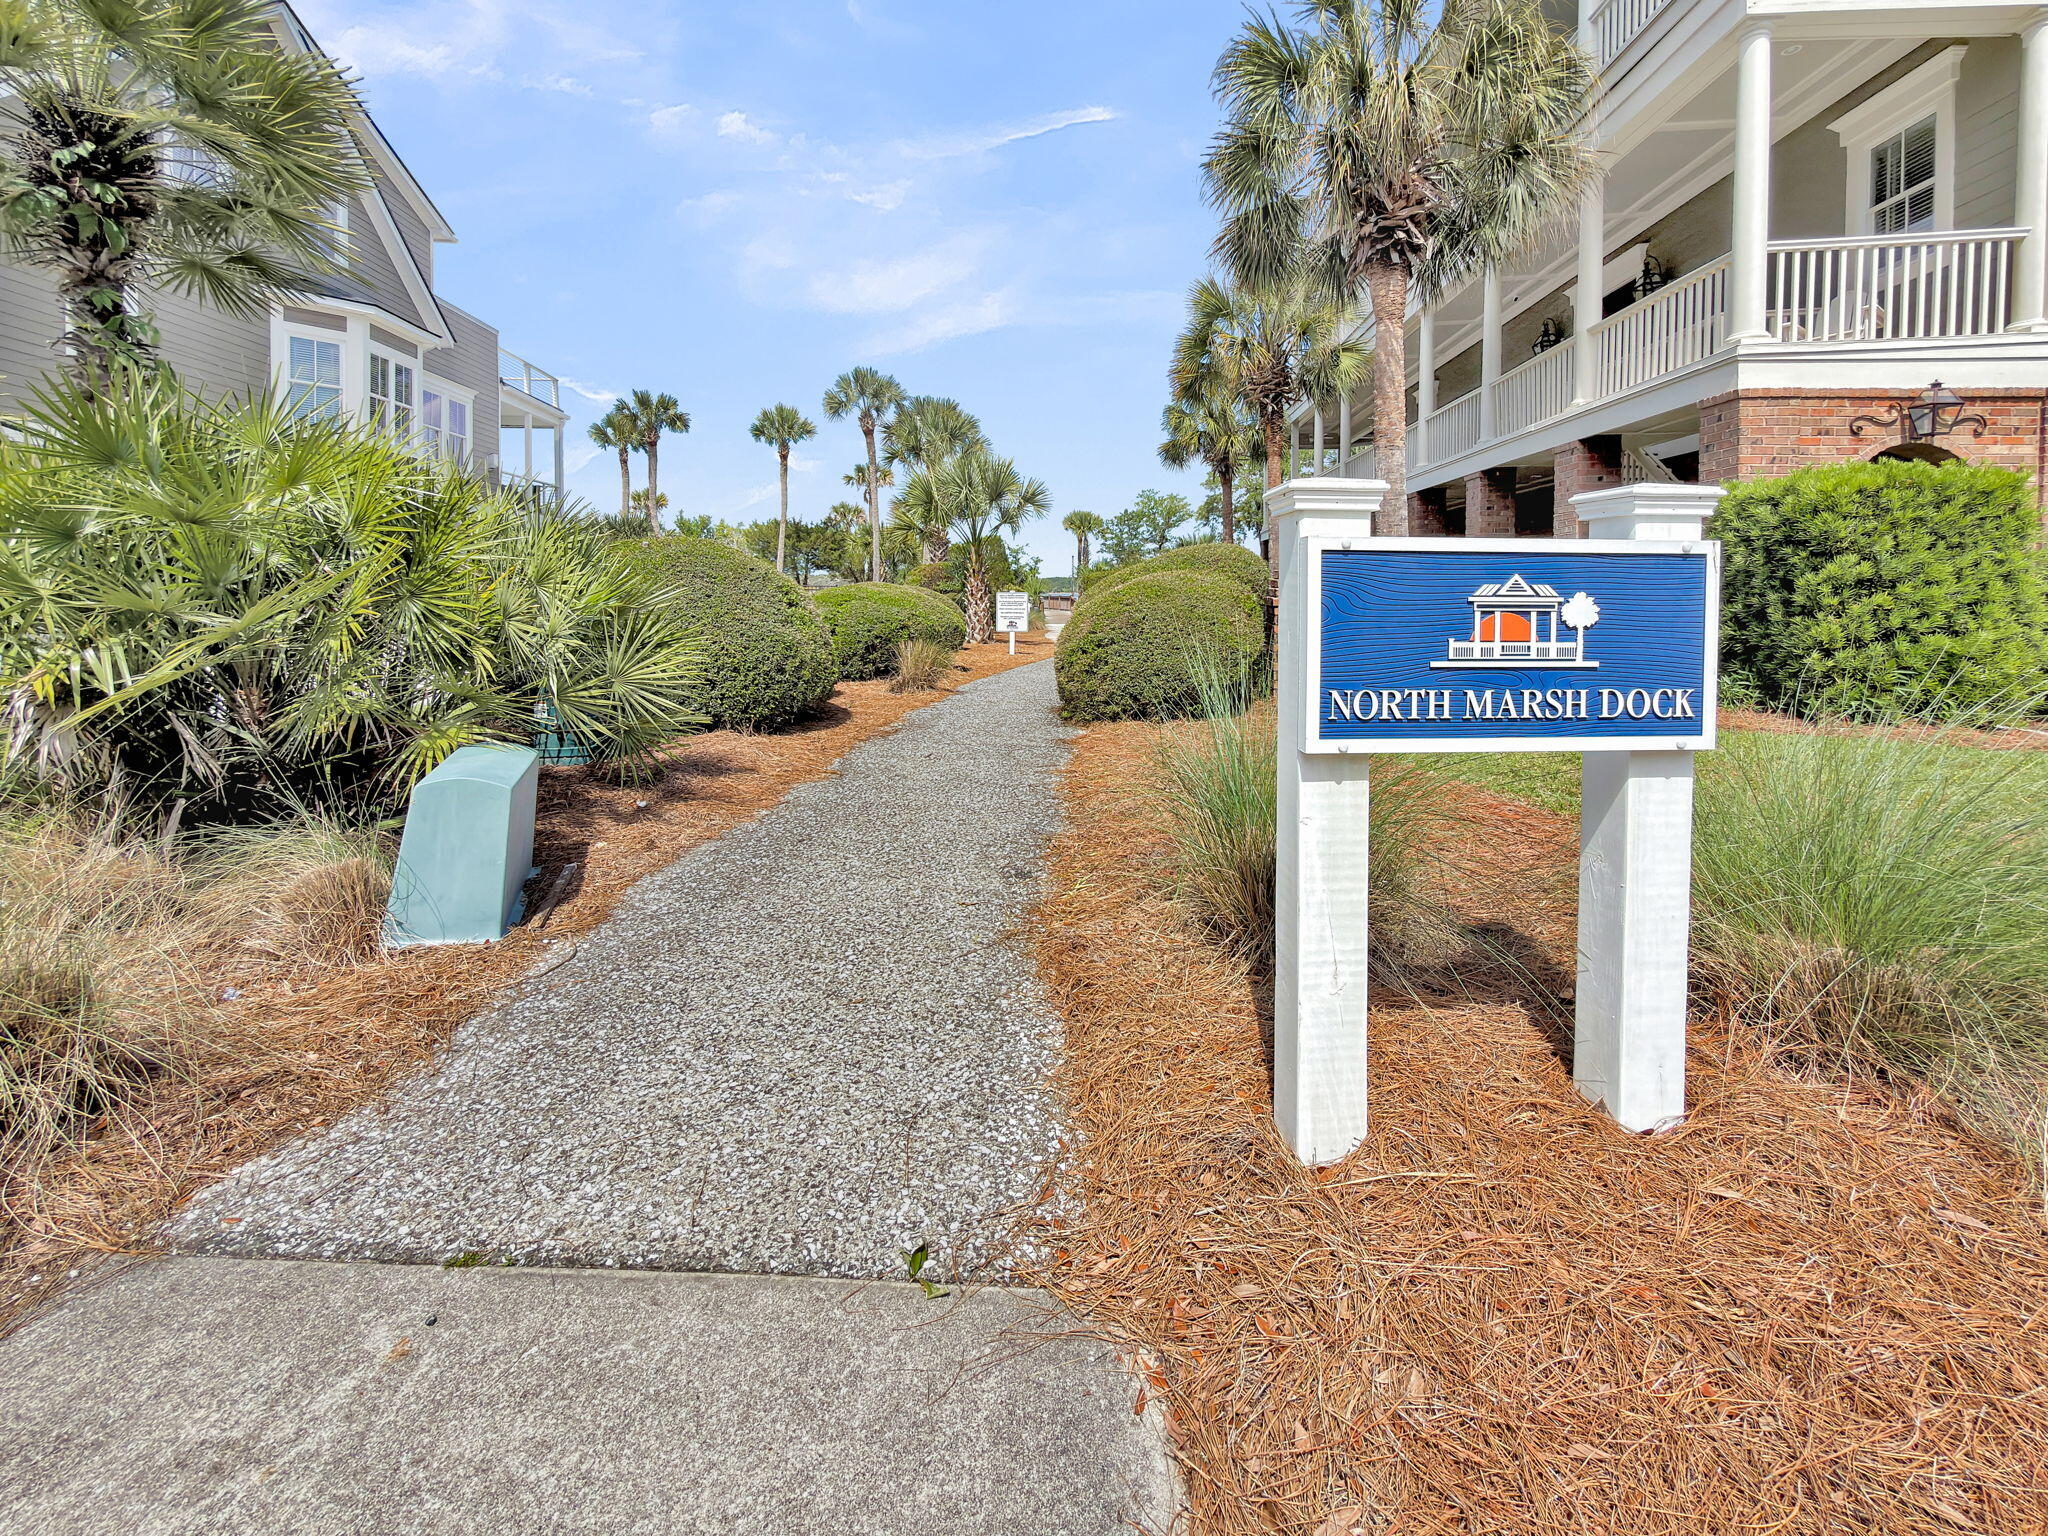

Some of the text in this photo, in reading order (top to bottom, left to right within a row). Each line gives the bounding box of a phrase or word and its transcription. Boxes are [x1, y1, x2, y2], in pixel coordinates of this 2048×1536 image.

[1327, 689, 1696, 720] NORTH MARSH DOCK
